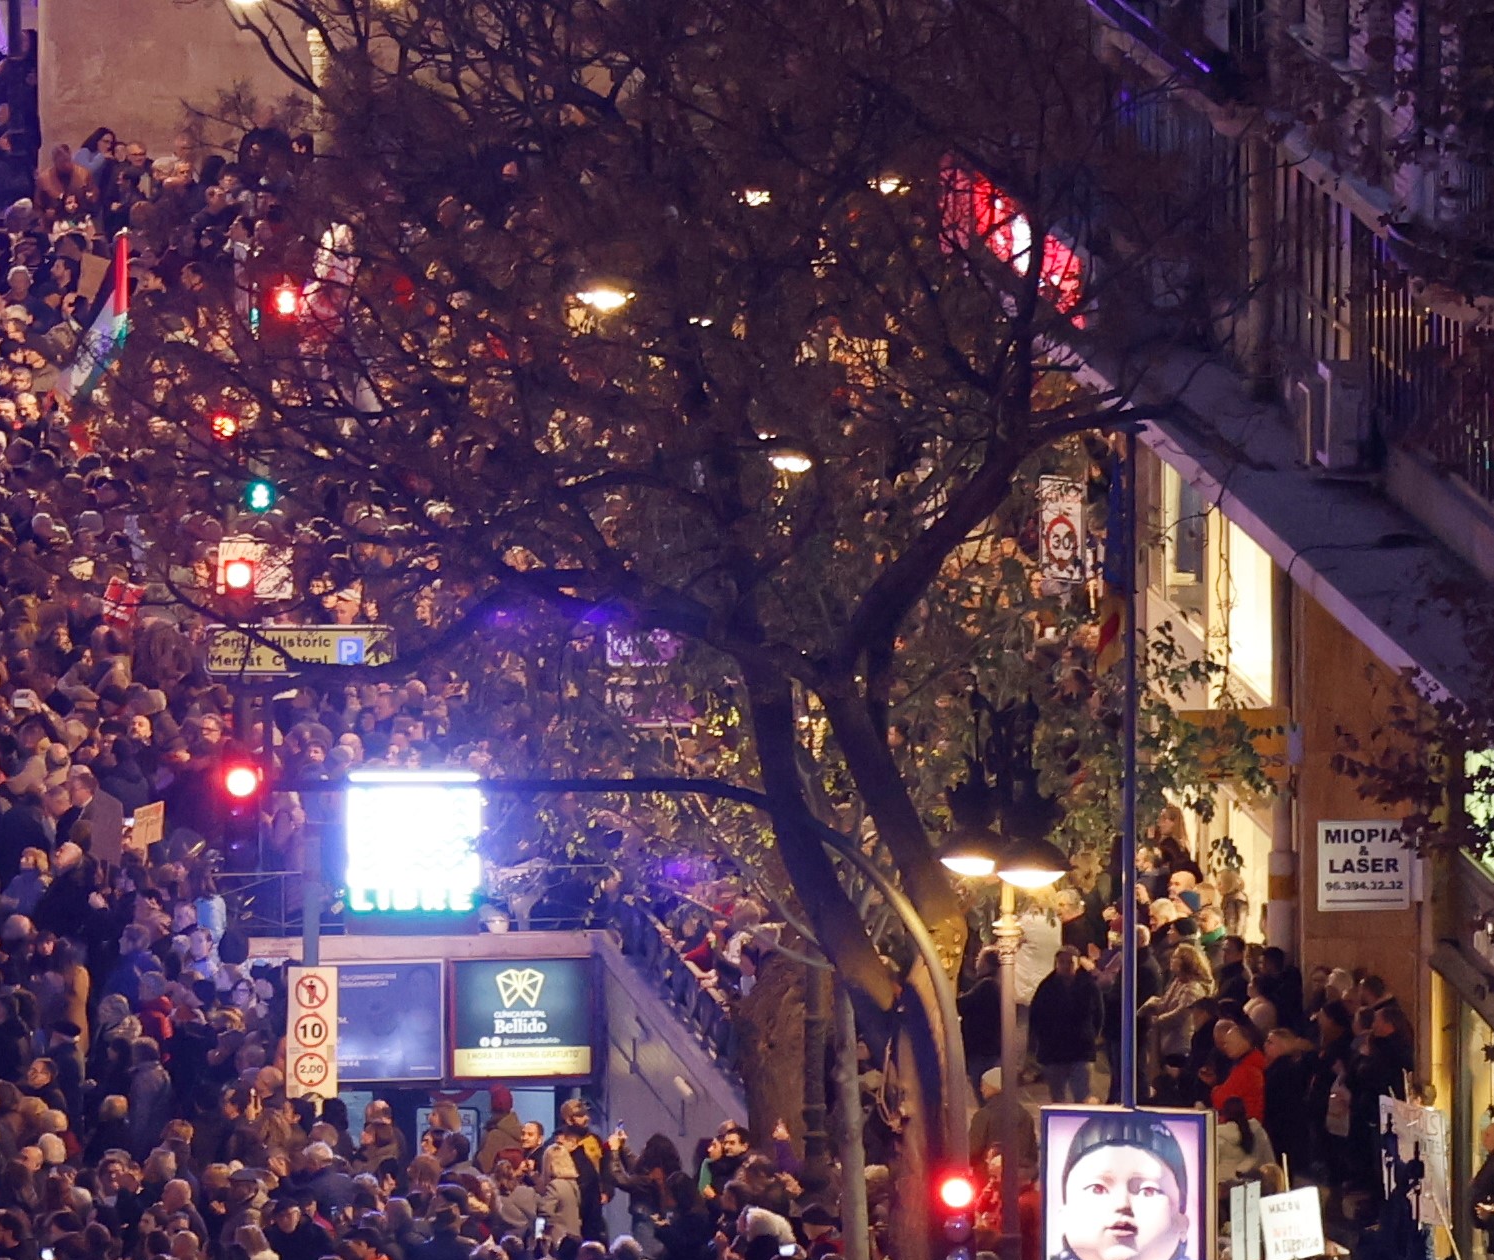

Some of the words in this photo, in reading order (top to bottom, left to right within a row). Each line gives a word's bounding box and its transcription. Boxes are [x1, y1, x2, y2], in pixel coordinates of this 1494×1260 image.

[1052, 533, 1071, 550] 30
[1324, 828, 1403, 844] MIOPIA
[1359, 845, 1369, 856] &
[1328, 858, 1399, 874] LASER
[299, 1023, 323, 1039] 10
[493, 1018, 547, 1034] Bellido
